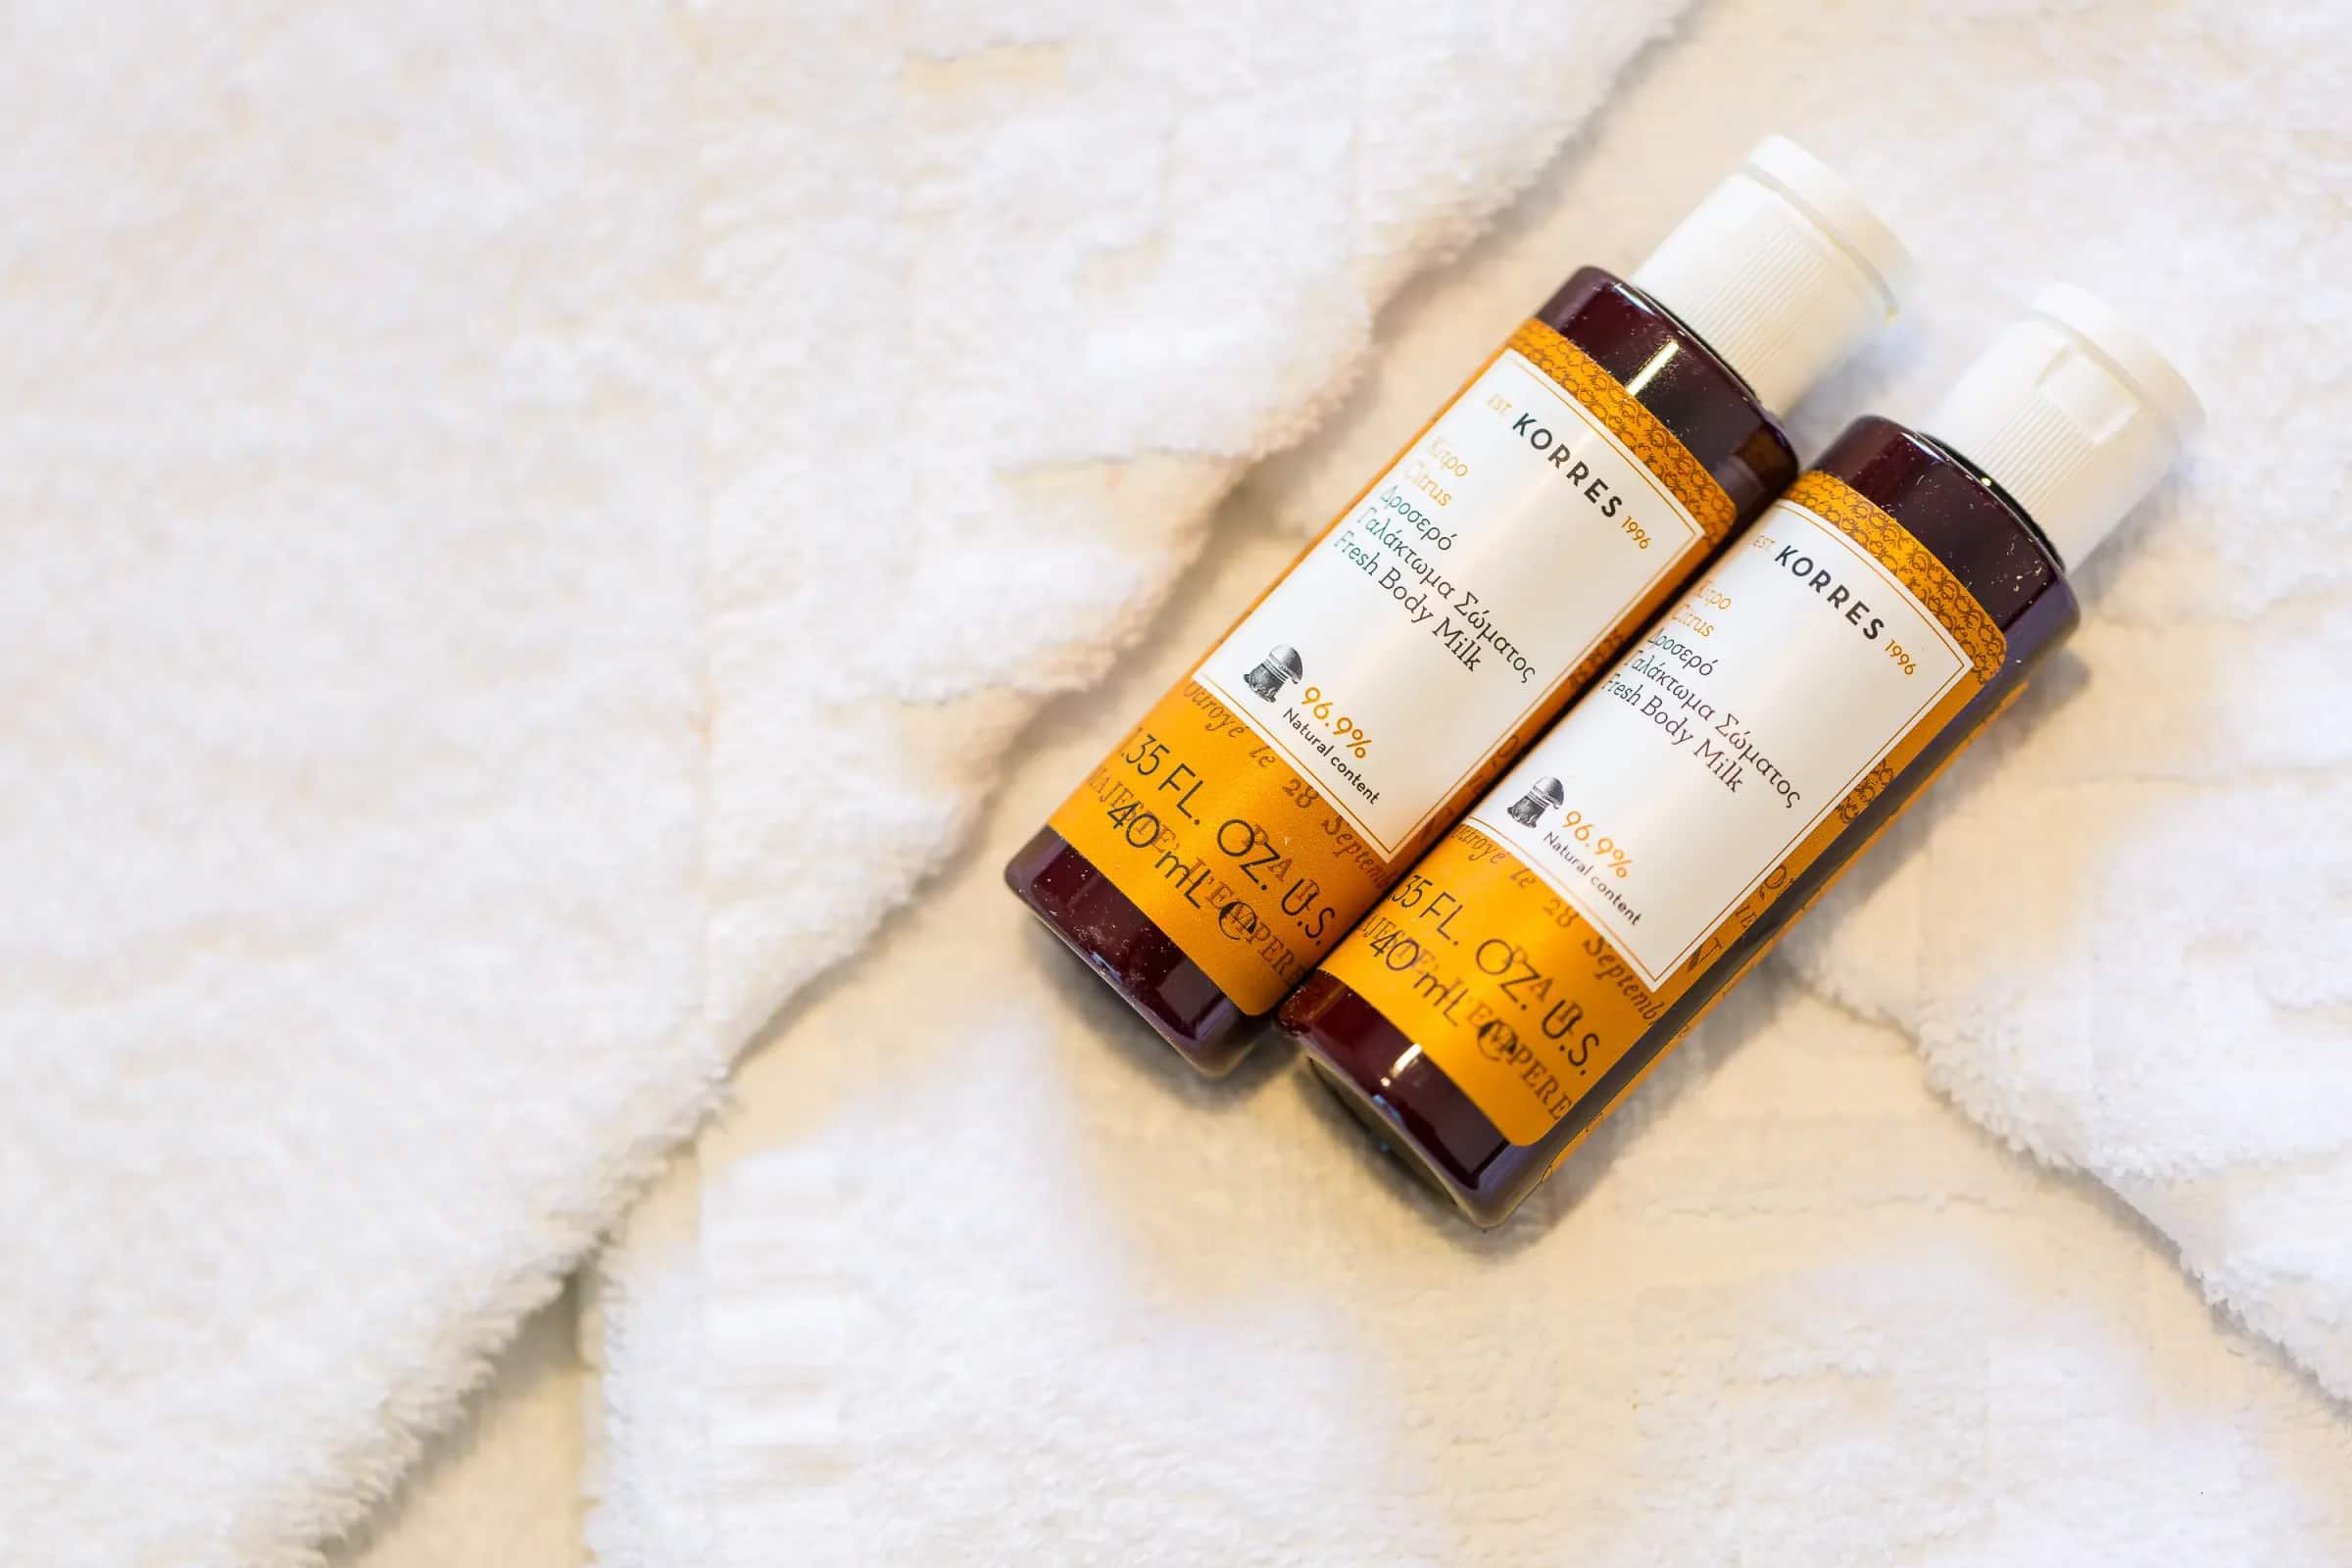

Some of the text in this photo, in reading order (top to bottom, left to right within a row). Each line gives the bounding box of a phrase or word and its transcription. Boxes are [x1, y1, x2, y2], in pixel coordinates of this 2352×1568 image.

[1380, 485, 1458, 551] Δροσερό
[1512, 413, 1623, 517] KORRES
[1621, 515, 1652, 550] 1996
[1334, 530, 1483, 672] Fresh Body Milk
[1356, 507, 1537, 684] Γαλάκτωμα Σώματος
[1775, 544, 1886, 641] KORRES
[1885, 638, 1917, 676] 1996
[1647, 627, 1719, 676] Δροσερό
[1282, 707, 1381, 807] Natural content
[1300, 685, 1373, 760] 96.9%
[1601, 672, 1743, 794] Fresh Body Milk
[1624, 650, 1801, 808] Γαλάκτωμα Σώματος
[1281, 777, 1320, 809] 28
[1561, 809, 1633, 879] 96.9%
[1106, 803, 1161, 849] 40
[1154, 850, 1211, 909] mL
[1157, 762, 1204, 826] FL.
[1216, 818, 1281, 892] OZ.
[1281, 877, 1336, 947] U.S.
[1543, 830, 1642, 927] Natural content
[1542, 897, 1581, 928] 28
[1369, 931, 1420, 971] 40
[1412, 971, 1469, 1028] mL
[1419, 891, 1464, 947] FL.
[1476, 938, 1542, 1011] OZ.
[1541, 999, 1600, 1077] U.S.
